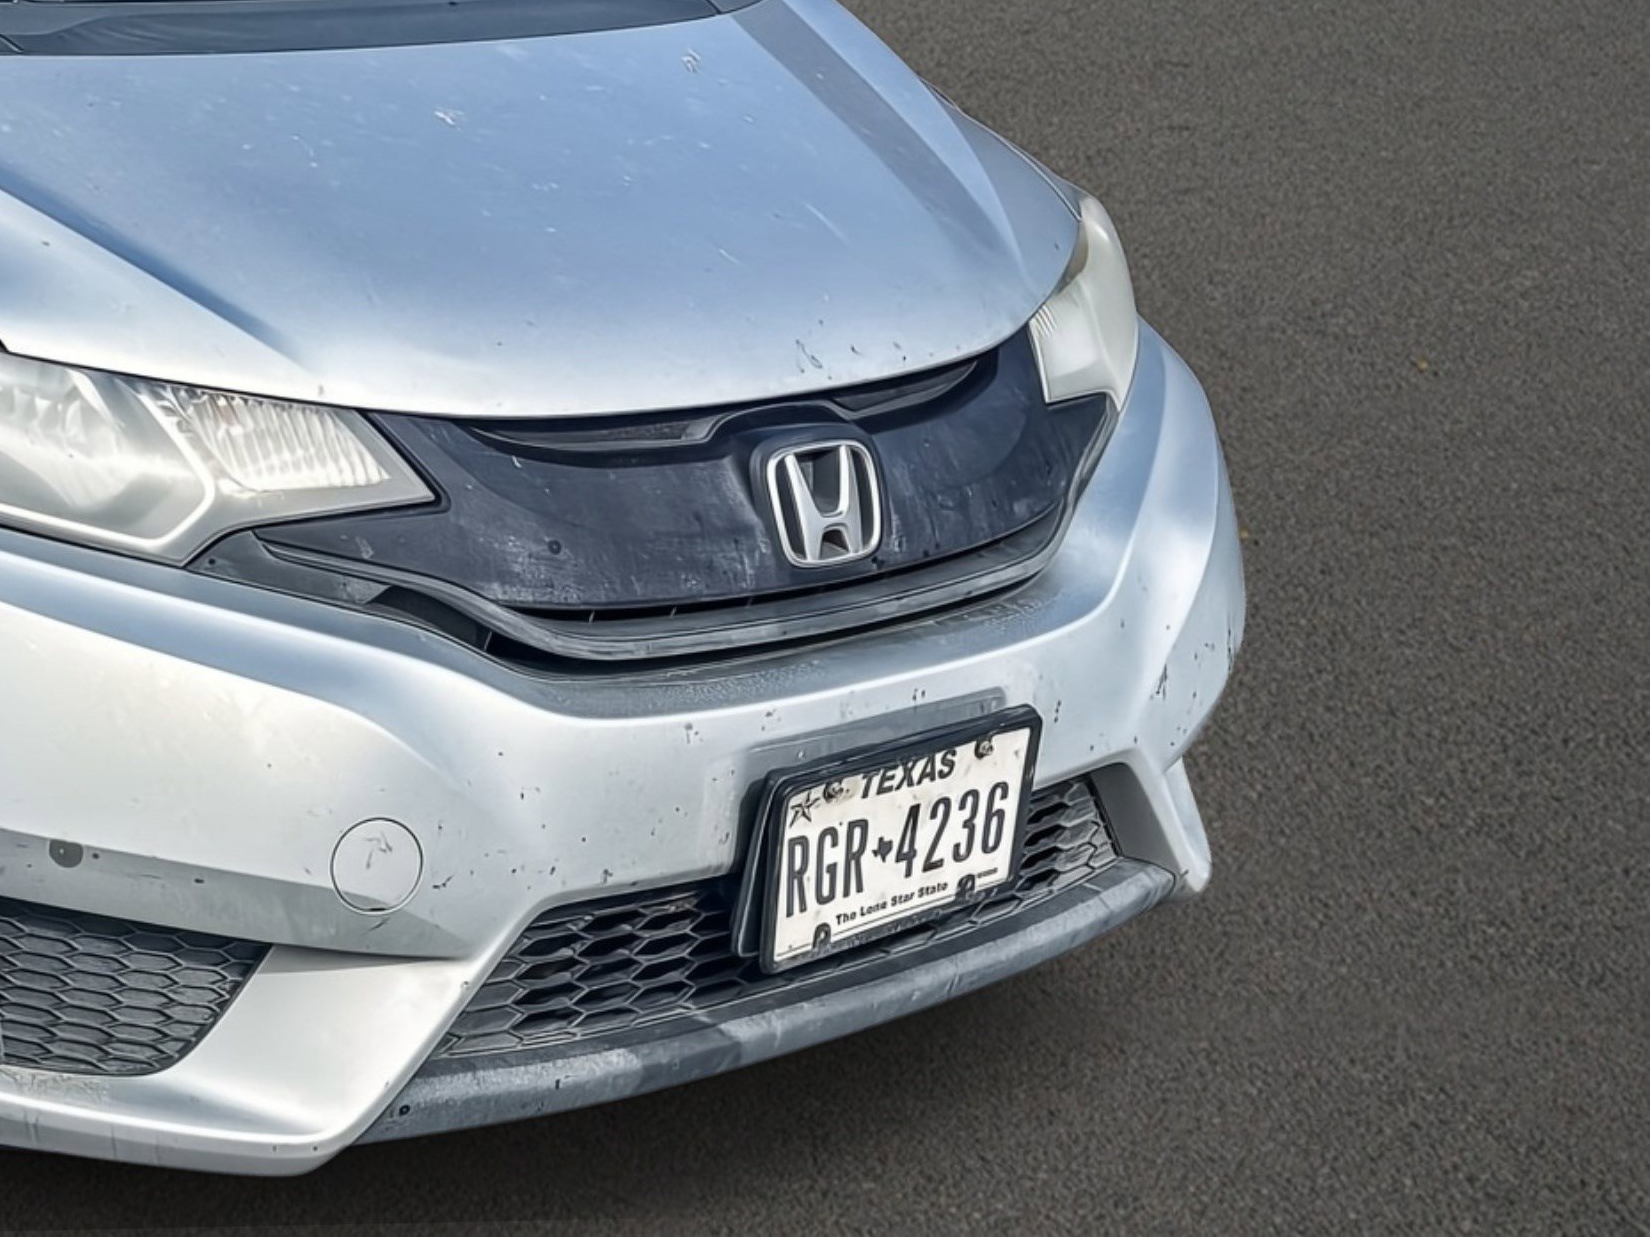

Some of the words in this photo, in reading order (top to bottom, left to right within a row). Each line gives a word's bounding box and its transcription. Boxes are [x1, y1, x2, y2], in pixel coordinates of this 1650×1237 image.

[861, 749, 956, 798] TEXAS
[785, 818, 869, 918] RGR
[895, 781, 1010, 878] 4236
[836, 912, 856, 925] The
[860, 901, 887, 917] Lone
[891, 892, 915, 907] Star
[918, 881, 948, 899] State
